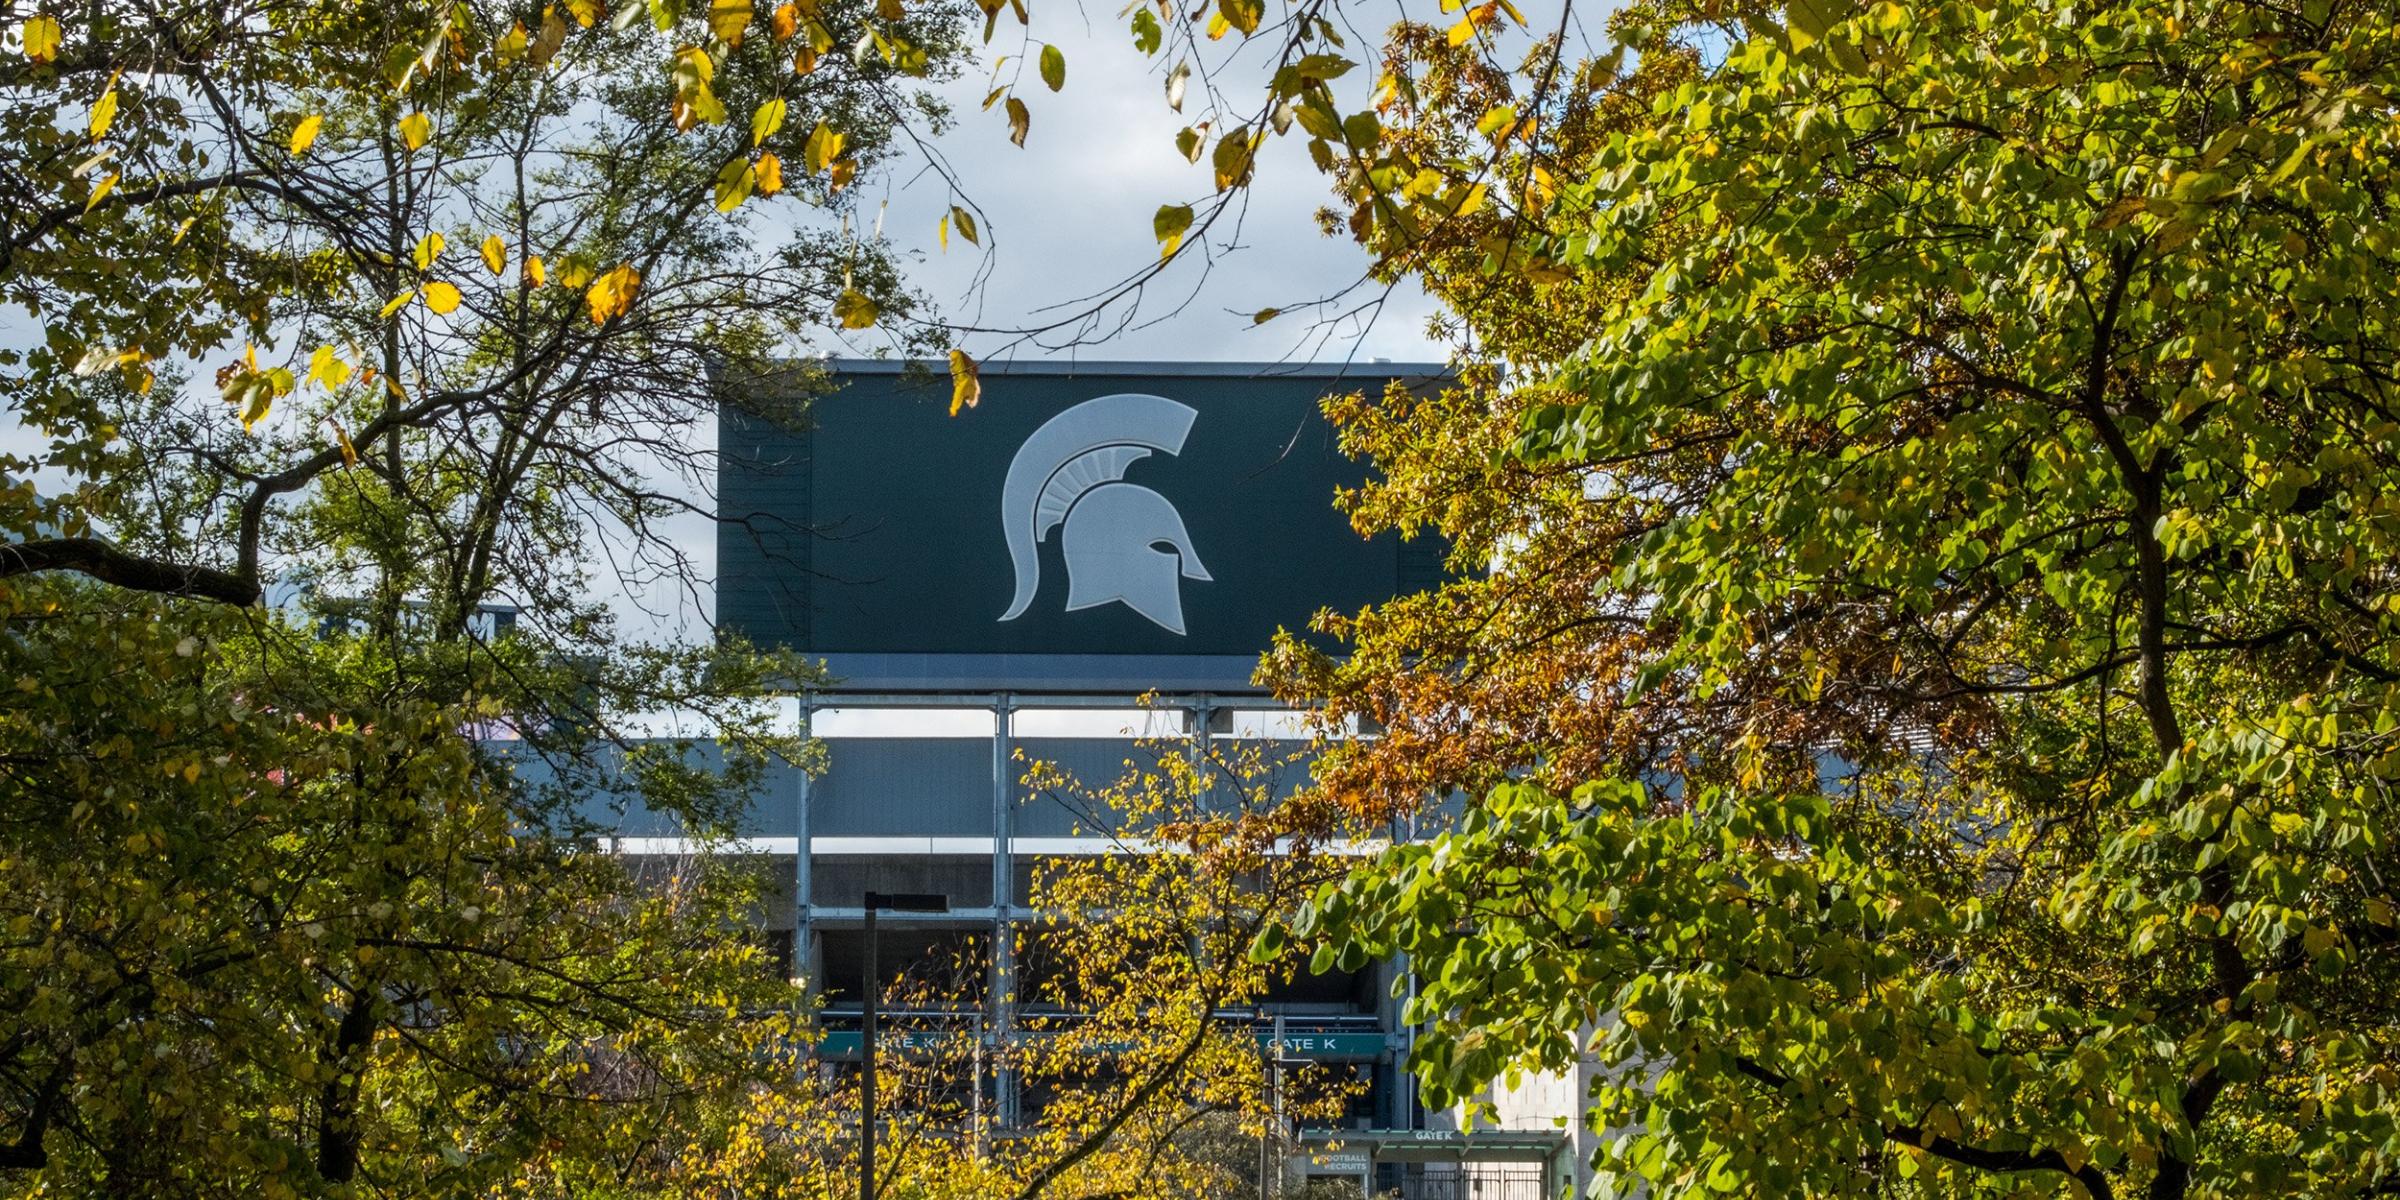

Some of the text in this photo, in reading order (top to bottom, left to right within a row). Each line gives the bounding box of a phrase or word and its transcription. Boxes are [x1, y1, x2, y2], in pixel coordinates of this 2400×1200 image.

[1324, 1039, 1337, 1049] K
[1415, 1131, 1453, 1140] GATE K
